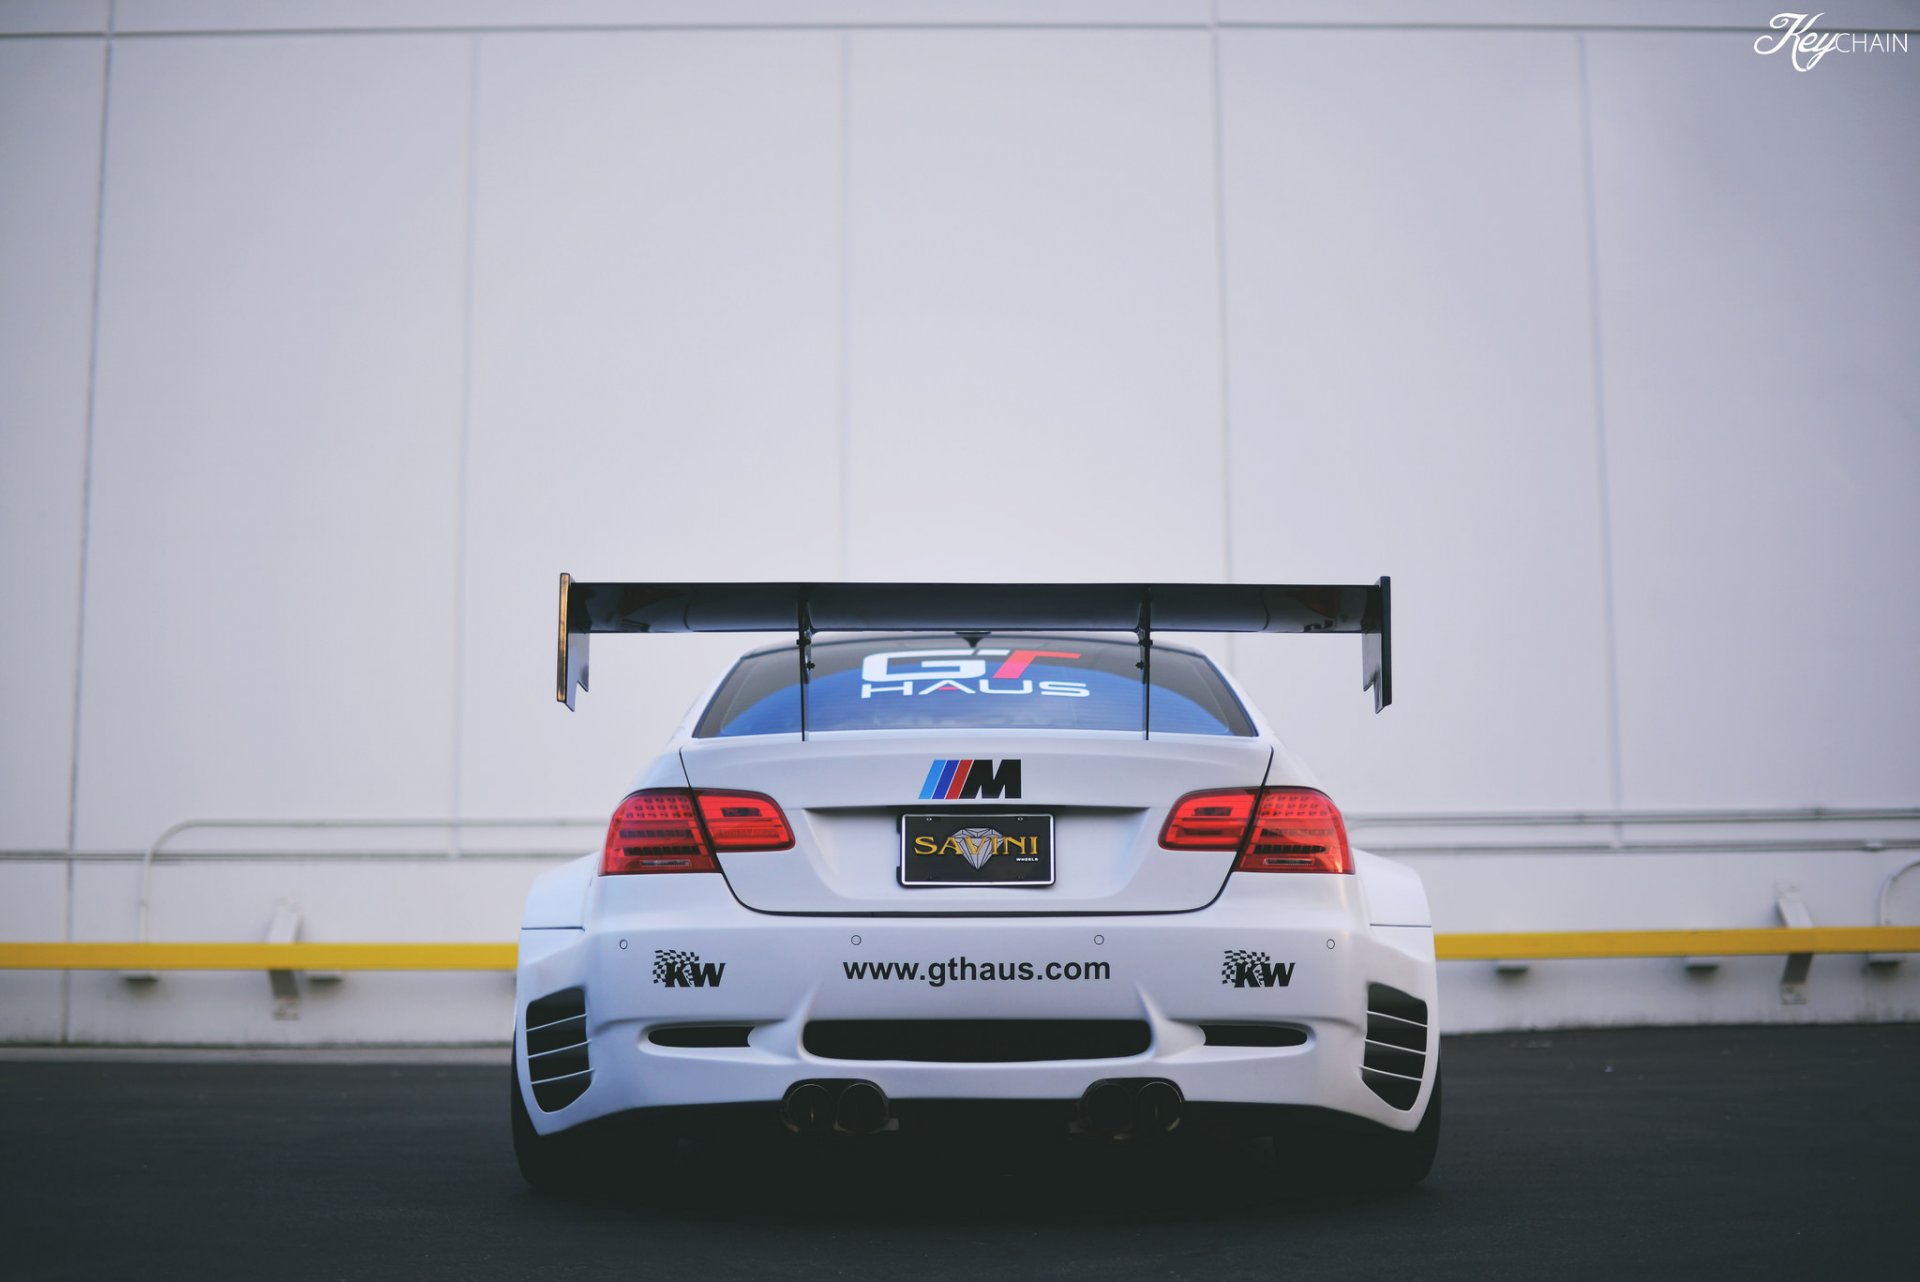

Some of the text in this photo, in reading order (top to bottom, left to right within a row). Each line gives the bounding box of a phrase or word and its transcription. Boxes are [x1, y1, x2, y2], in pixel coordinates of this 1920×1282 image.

[862, 649, 1081, 682] GT
[861, 679, 1090, 698] HAUS
[958, 759, 1022, 799] M
[914, 836, 1038, 855] SAVINI
[665, 960, 726, 987] KW
[843, 957, 1110, 987] www.gthaus.com
[1234, 960, 1296, 988] KW
